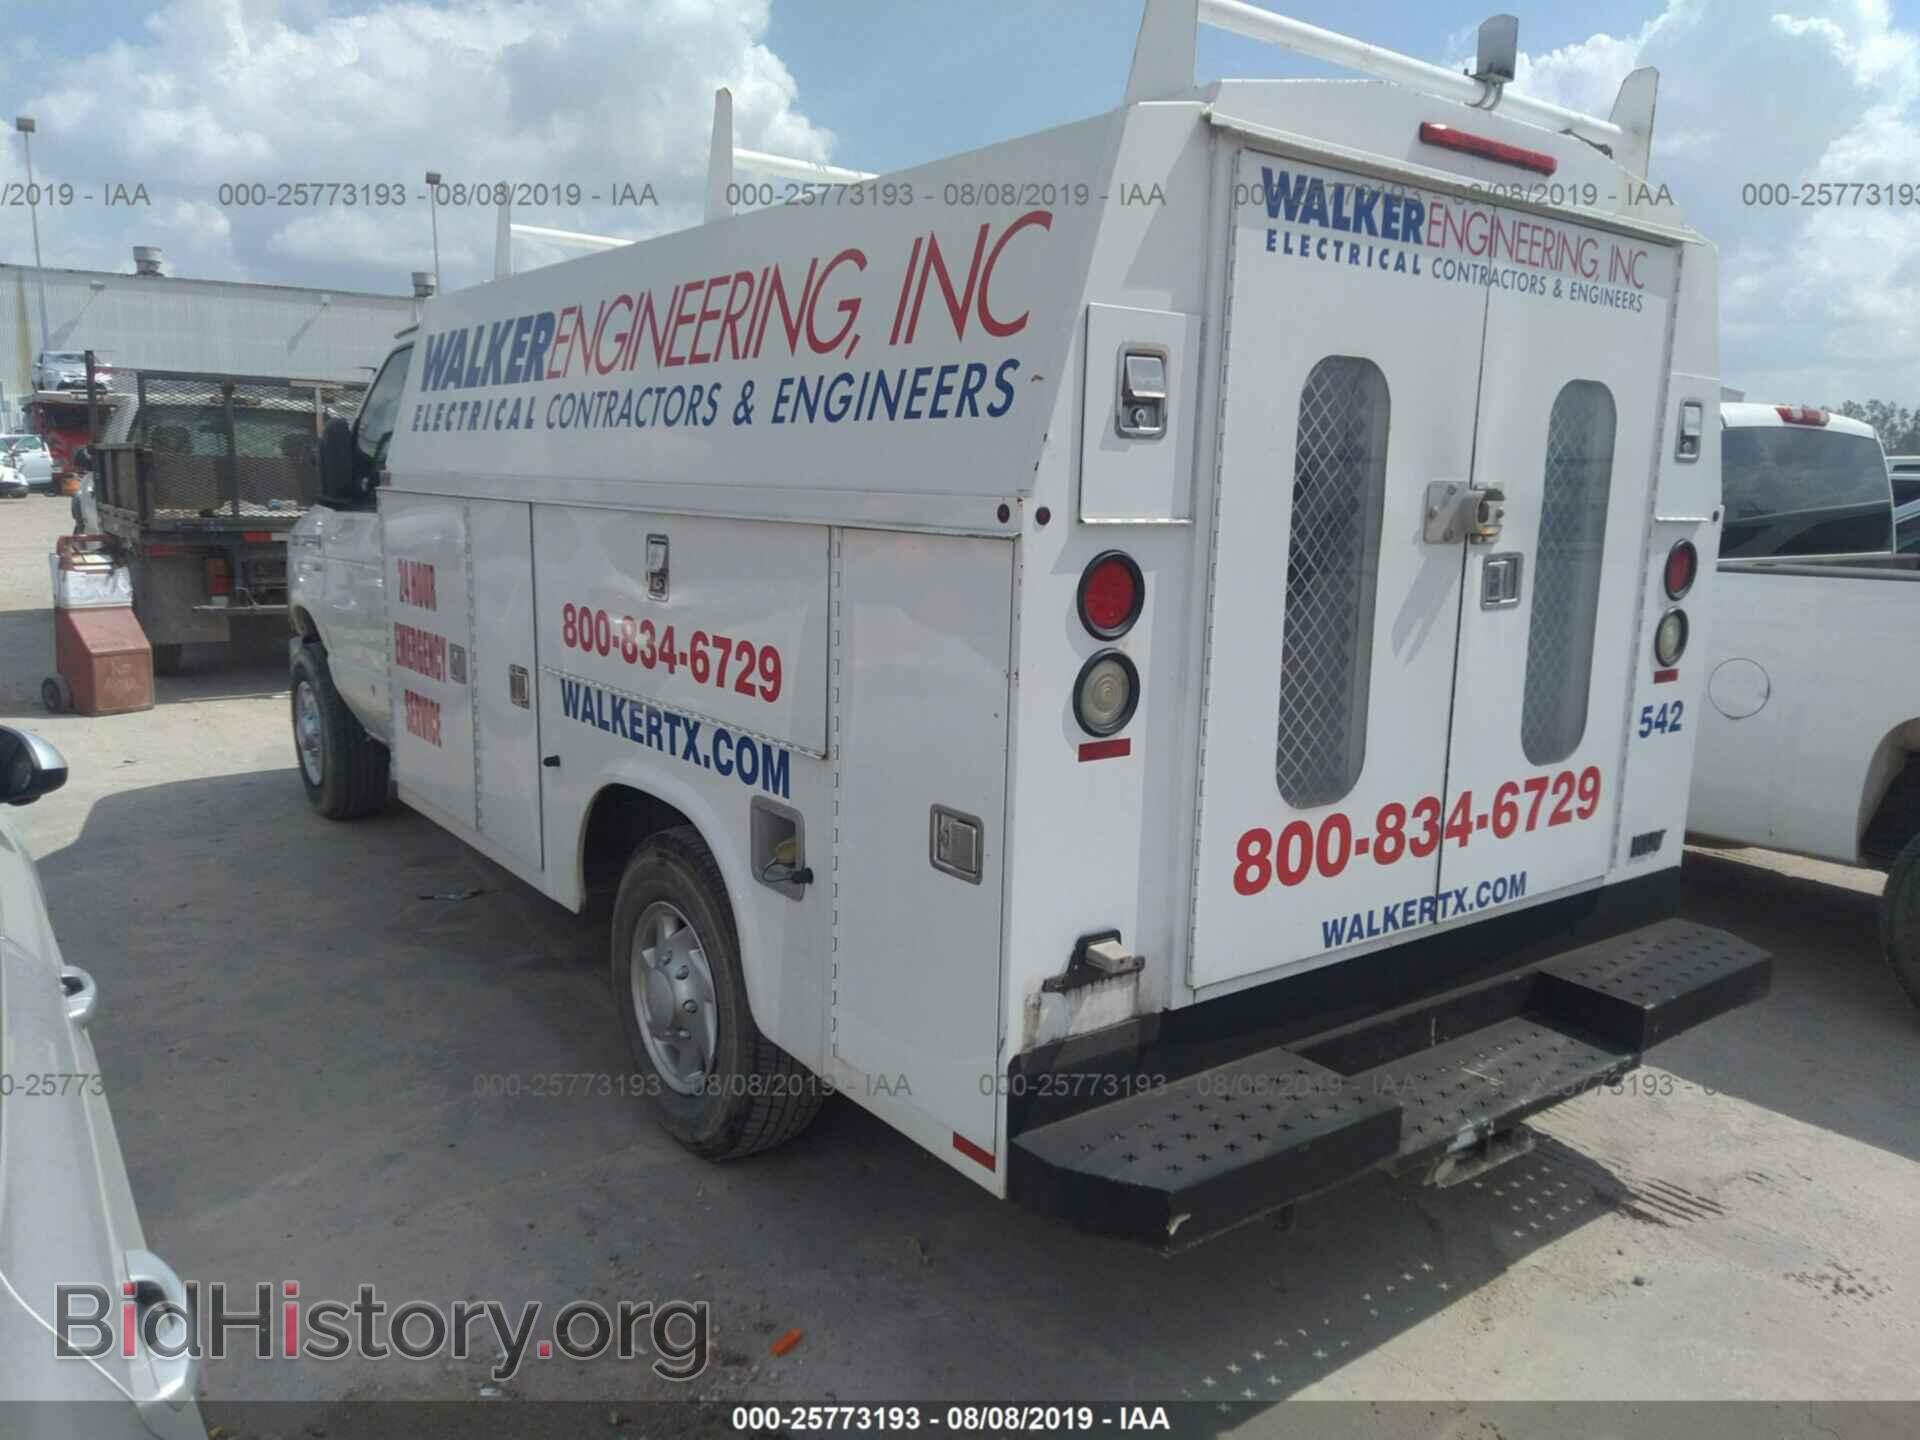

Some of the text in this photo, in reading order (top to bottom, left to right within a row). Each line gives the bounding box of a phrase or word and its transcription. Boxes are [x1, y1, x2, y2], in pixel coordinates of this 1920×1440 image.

[1261, 166, 1426, 246] WALKER
[1608, 244, 1649, 289] INC
[1265, 228, 1644, 313] ELECTRICAL CONTRACTORS & ENGINEERS
[420, 311, 557, 392] WALKER
[887, 210, 1053, 346] INC
[411, 358, 1021, 432] ELECTRICAL CONTRACTORS & ENGINEERS
[562, 602, 783, 703] 800-834-6729
[560, 678, 791, 800] WALKERTX.COM
[1638, 700, 1684, 739] 542
[1232, 765, 1602, 897] 800-834-6729
[1321, 870, 1527, 949] WALKERTX.COM
